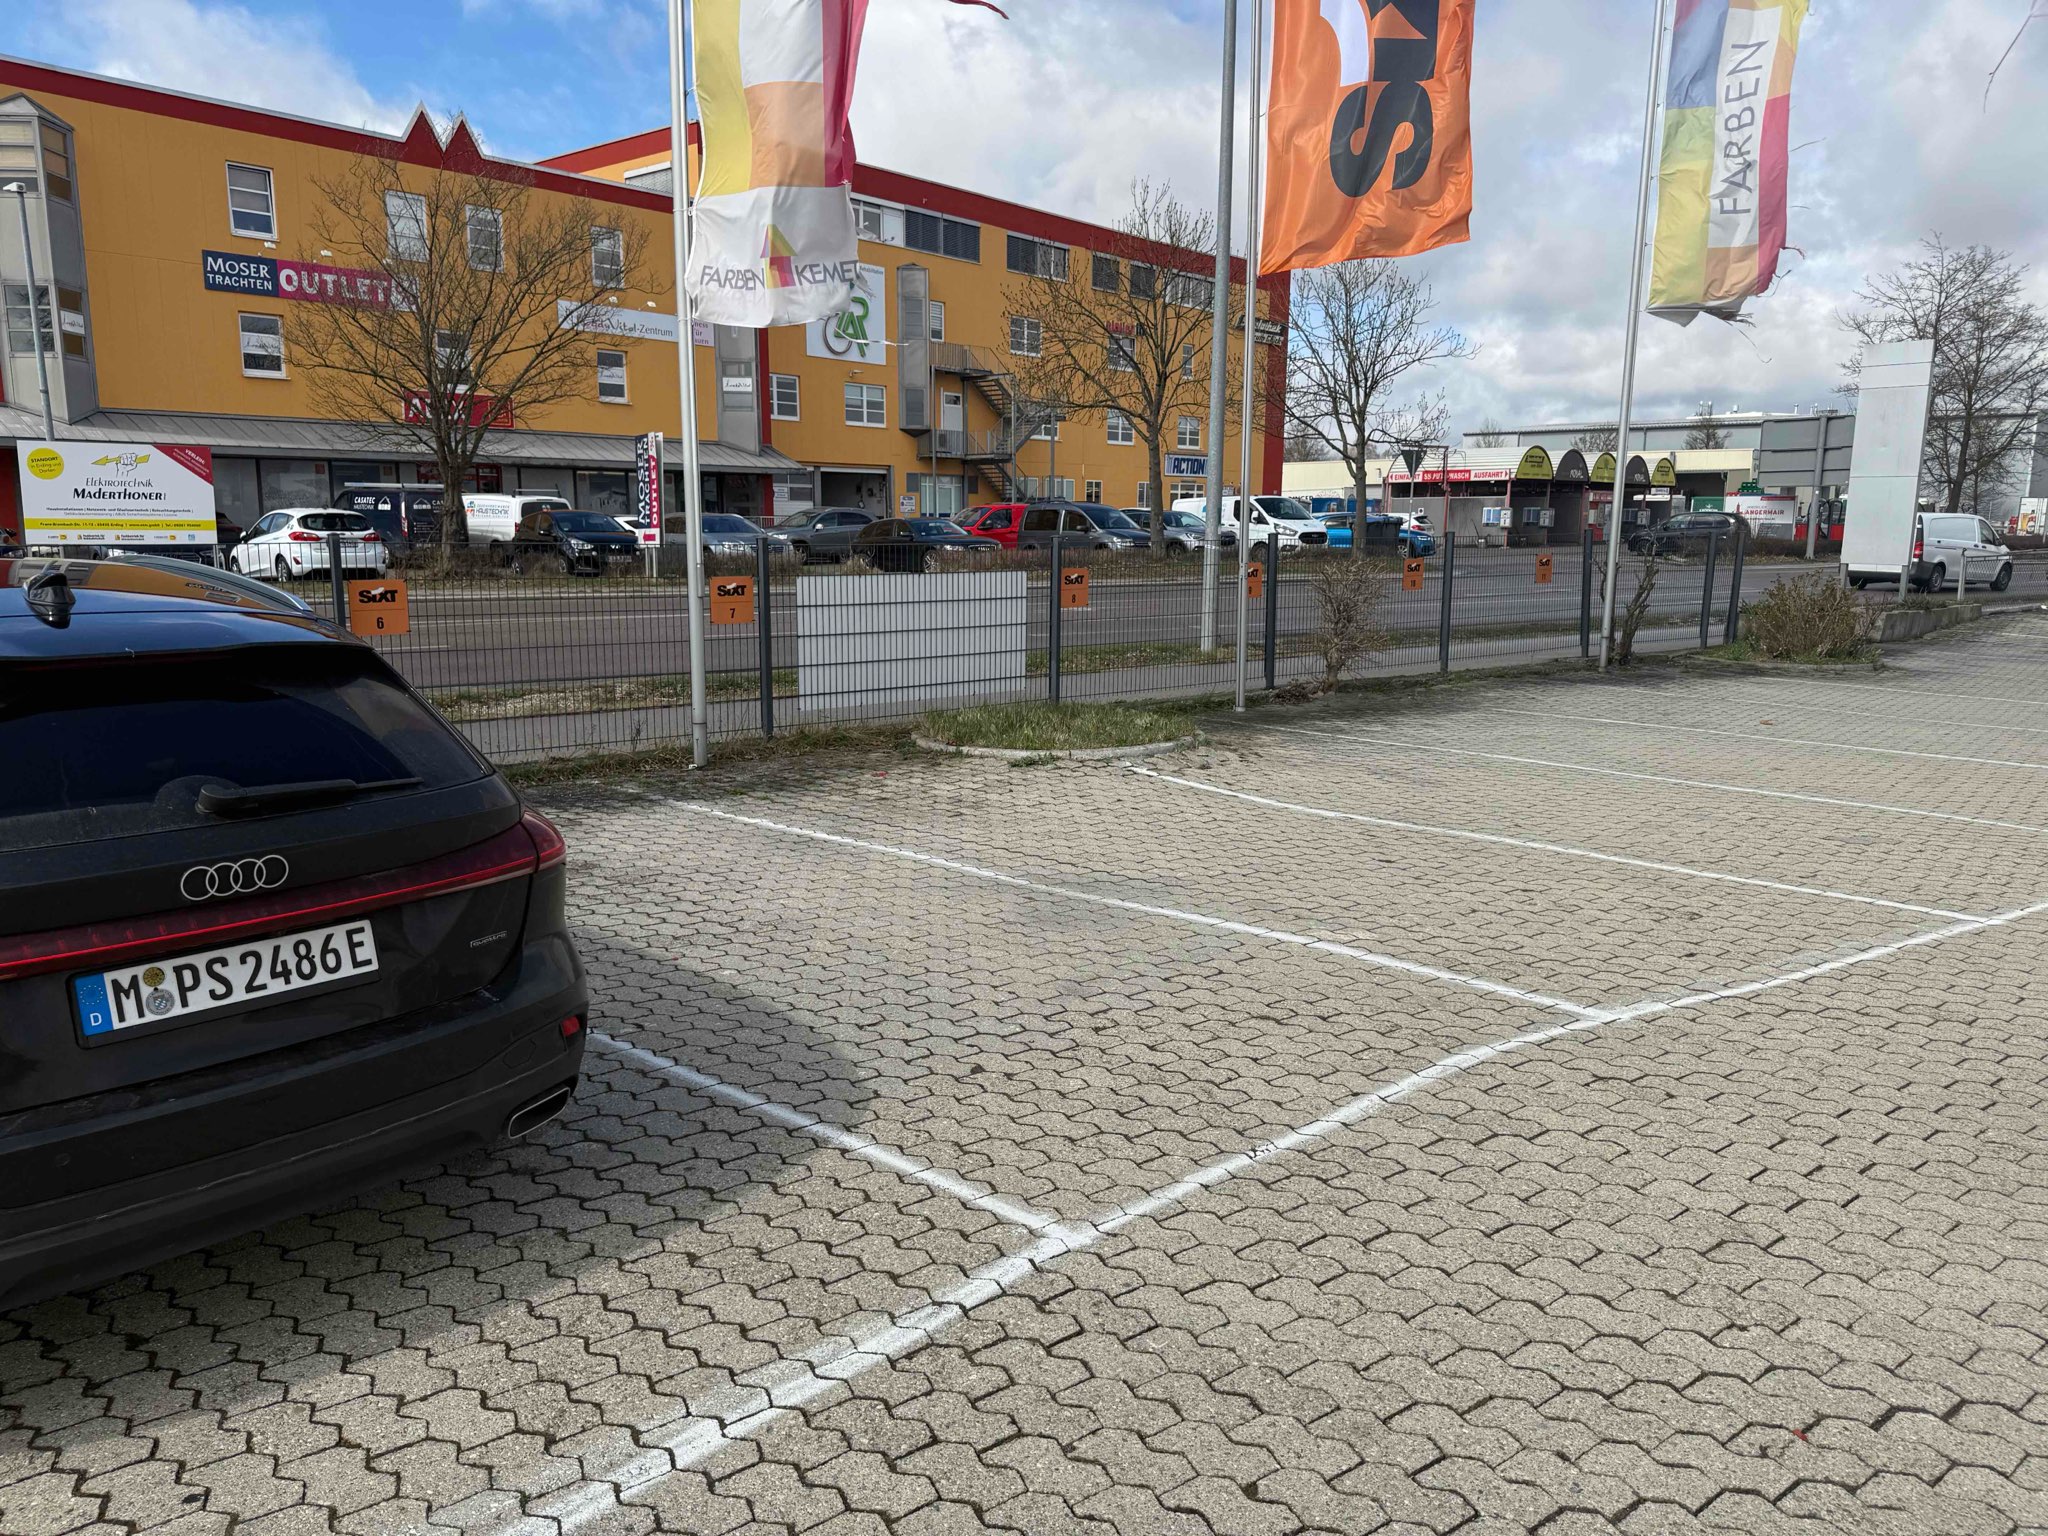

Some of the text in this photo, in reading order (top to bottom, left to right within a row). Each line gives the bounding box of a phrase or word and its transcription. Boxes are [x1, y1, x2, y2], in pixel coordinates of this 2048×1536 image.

[1718, 39, 1770, 216] FARBEN
[206, 257, 271, 278] MOSER
[207, 274, 272, 290] TRACHTEN
[279, 268, 388, 302] OUTLET
[700, 265, 766, 291] FARBEN
[1173, 457, 1205, 475] ACTION
[650, 459, 658, 526] OUTLET
[1064, 573, 1085, 585] SIXT
[358, 587, 399, 604] SIXT
[717, 583, 747, 597] SIXT
[729, 607, 736, 619] 7
[376, 616, 385, 630] 6
[111, 974, 147, 1024] M
[89, 1012, 103, 1026] D
